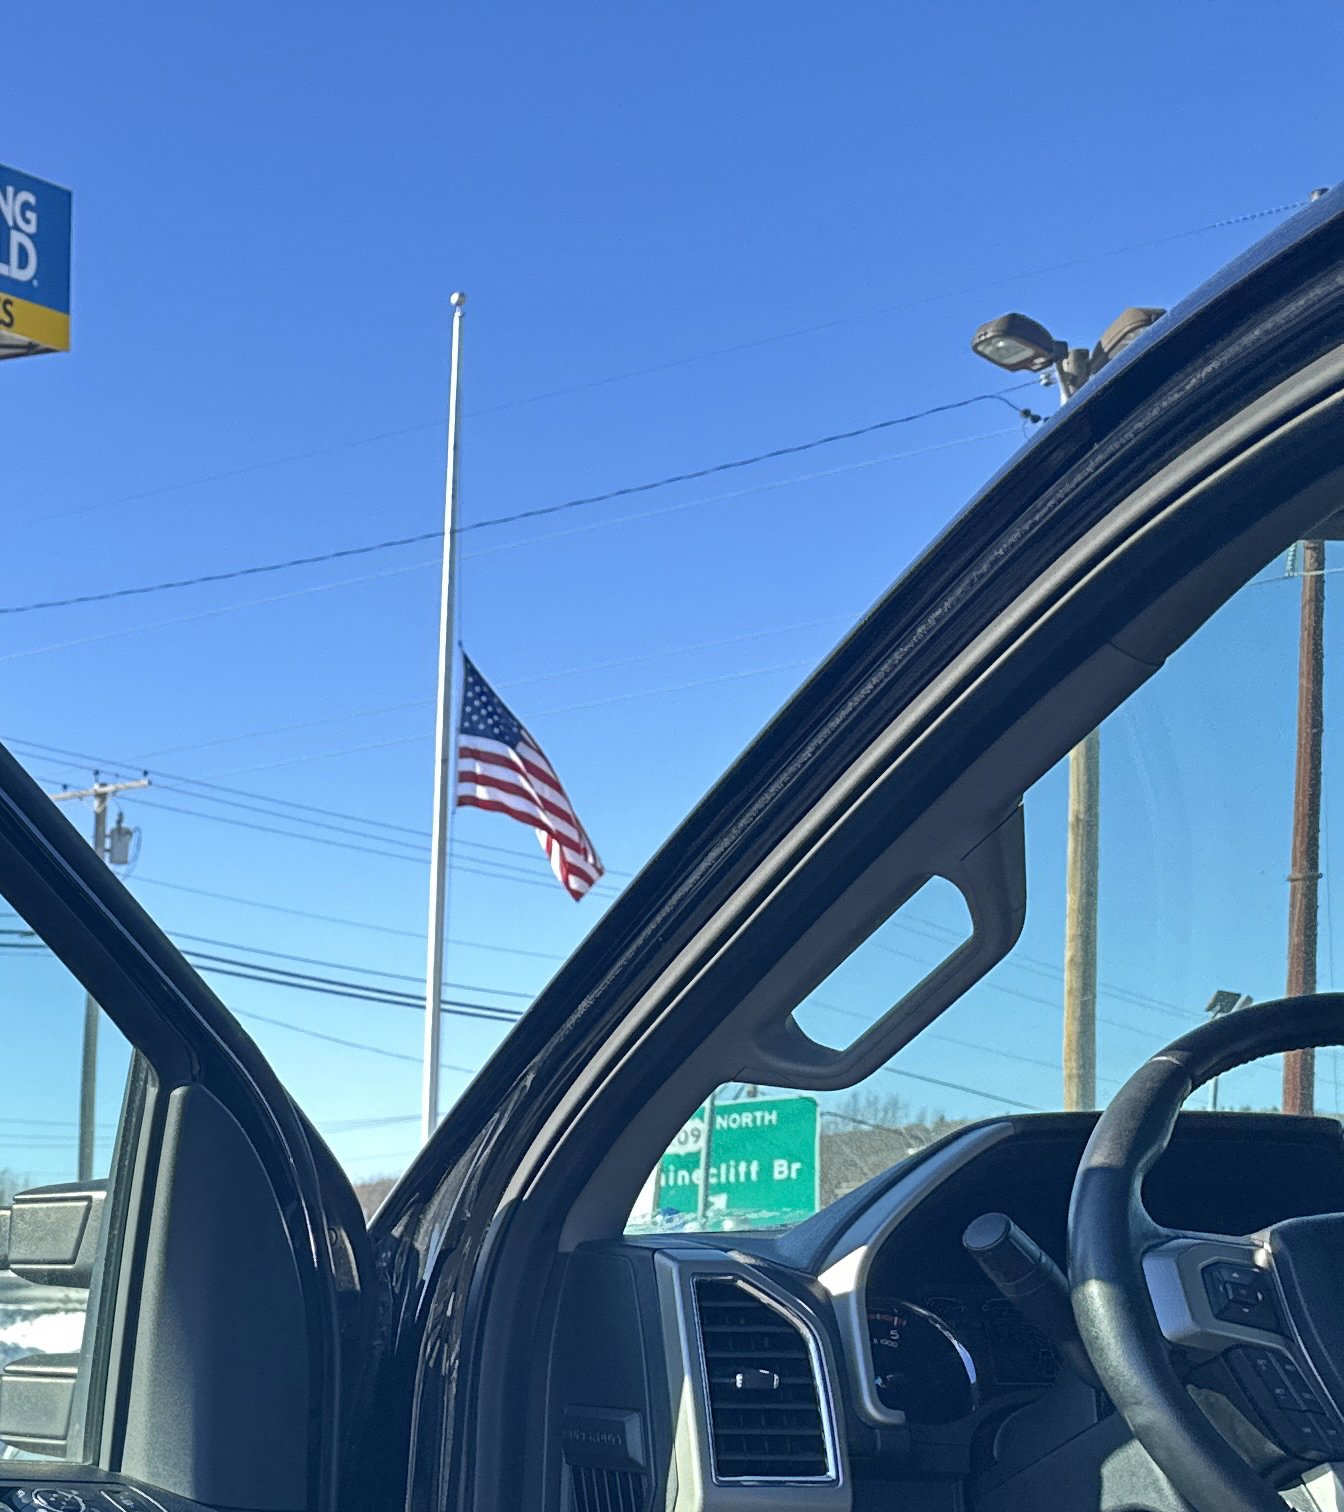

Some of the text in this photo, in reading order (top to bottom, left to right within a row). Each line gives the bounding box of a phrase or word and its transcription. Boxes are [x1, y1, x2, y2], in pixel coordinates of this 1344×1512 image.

[715, 1110, 778, 1131] NORTH
[773, 1159, 803, 1180] Br
[890, 1329, 900, 1340] 5
